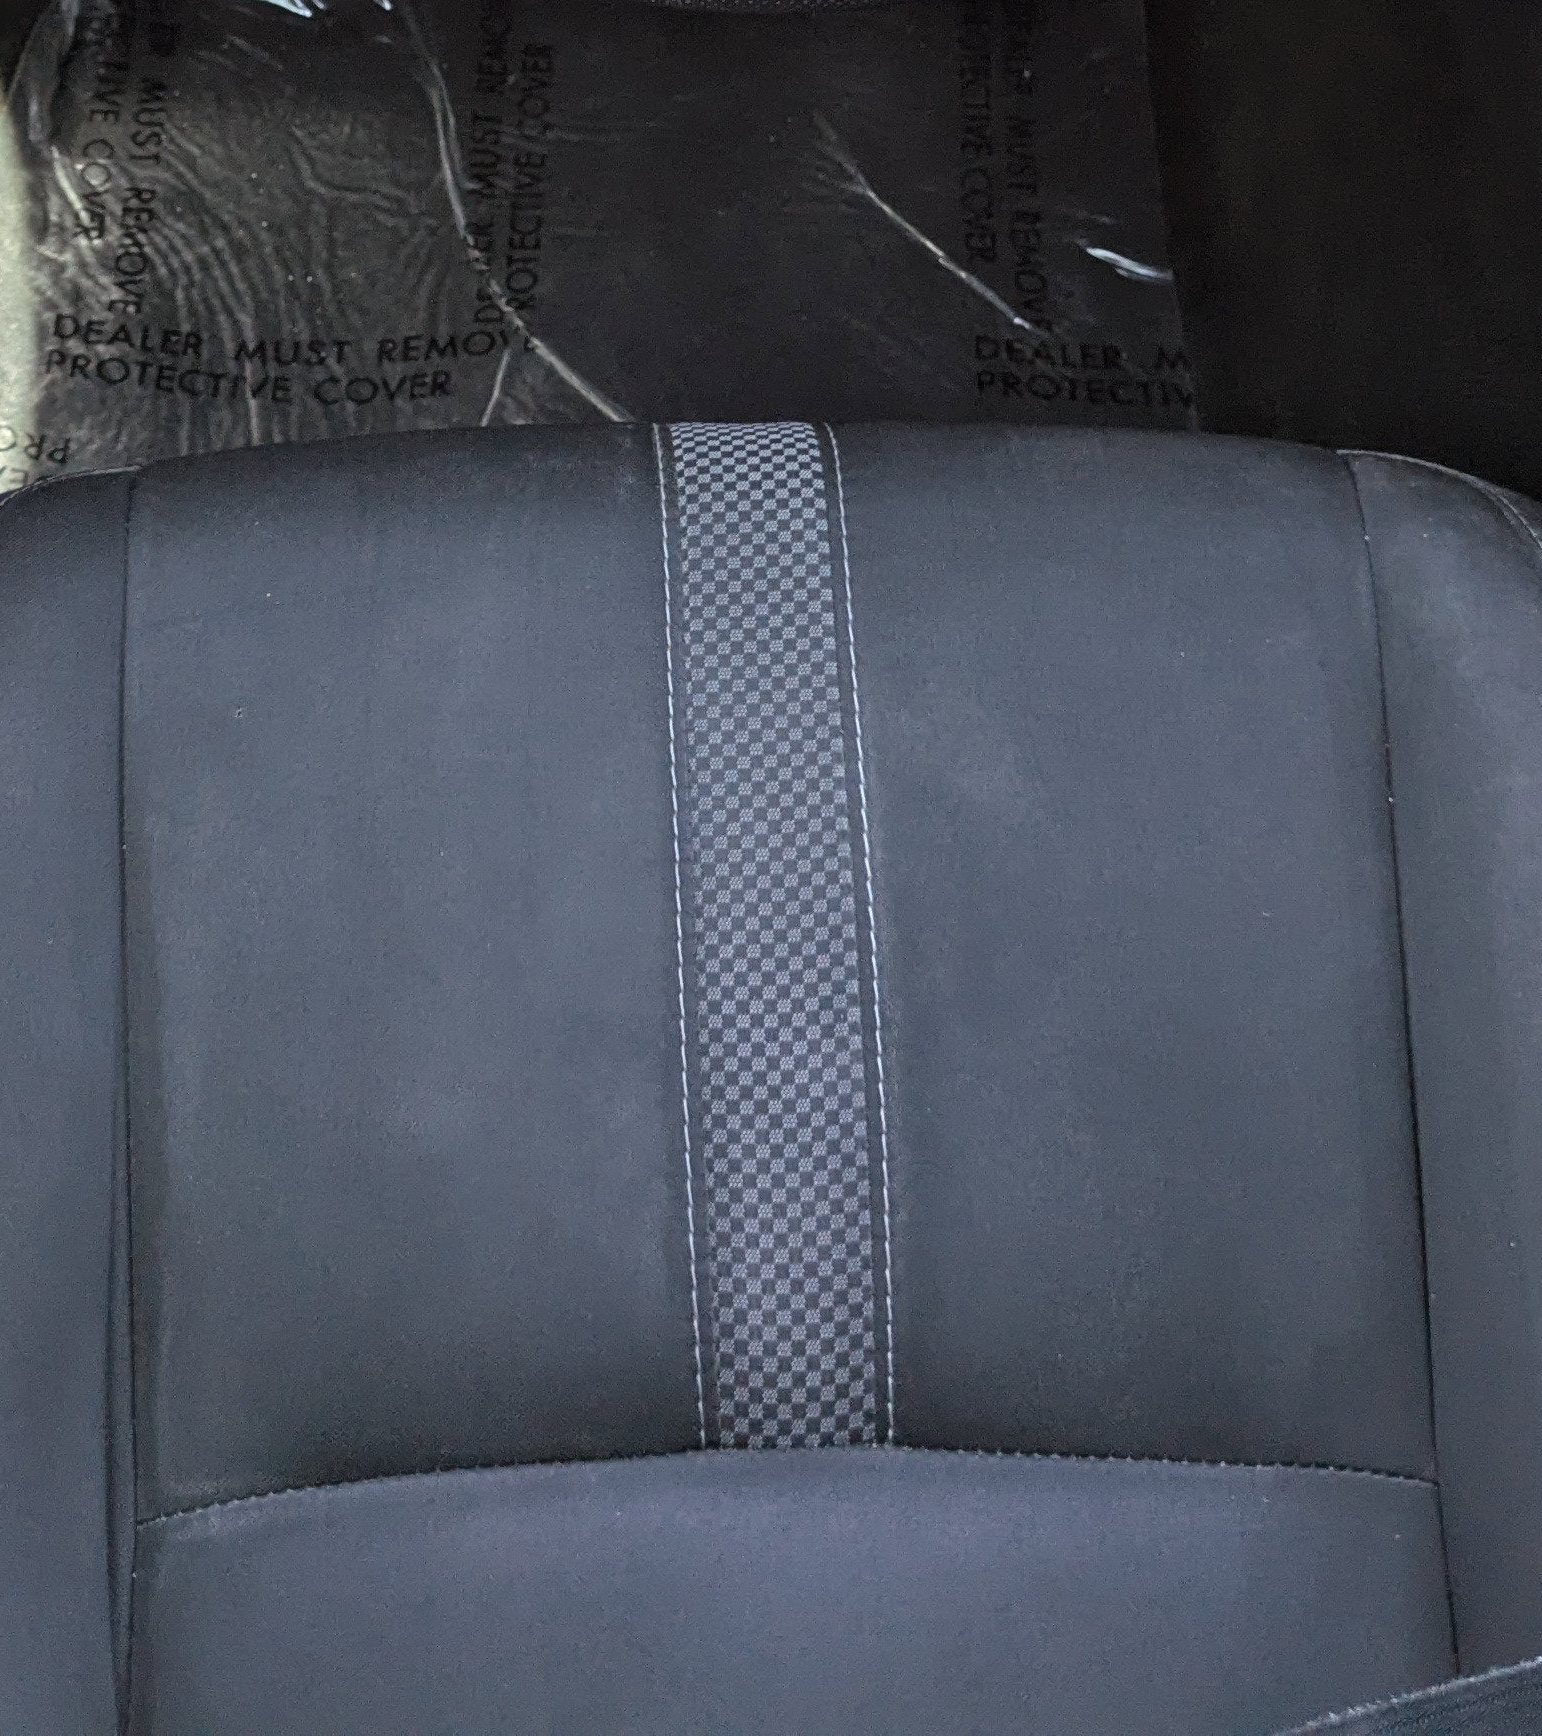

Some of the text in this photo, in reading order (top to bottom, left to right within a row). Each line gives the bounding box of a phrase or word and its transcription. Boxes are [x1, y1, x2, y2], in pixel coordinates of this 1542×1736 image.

[53, 313, 204, 360] DEALER
[234, 338, 354, 366] MUST
[974, 333, 1122, 372] DEALER
[45, 347, 452, 406] PROTECTIVE COVER
